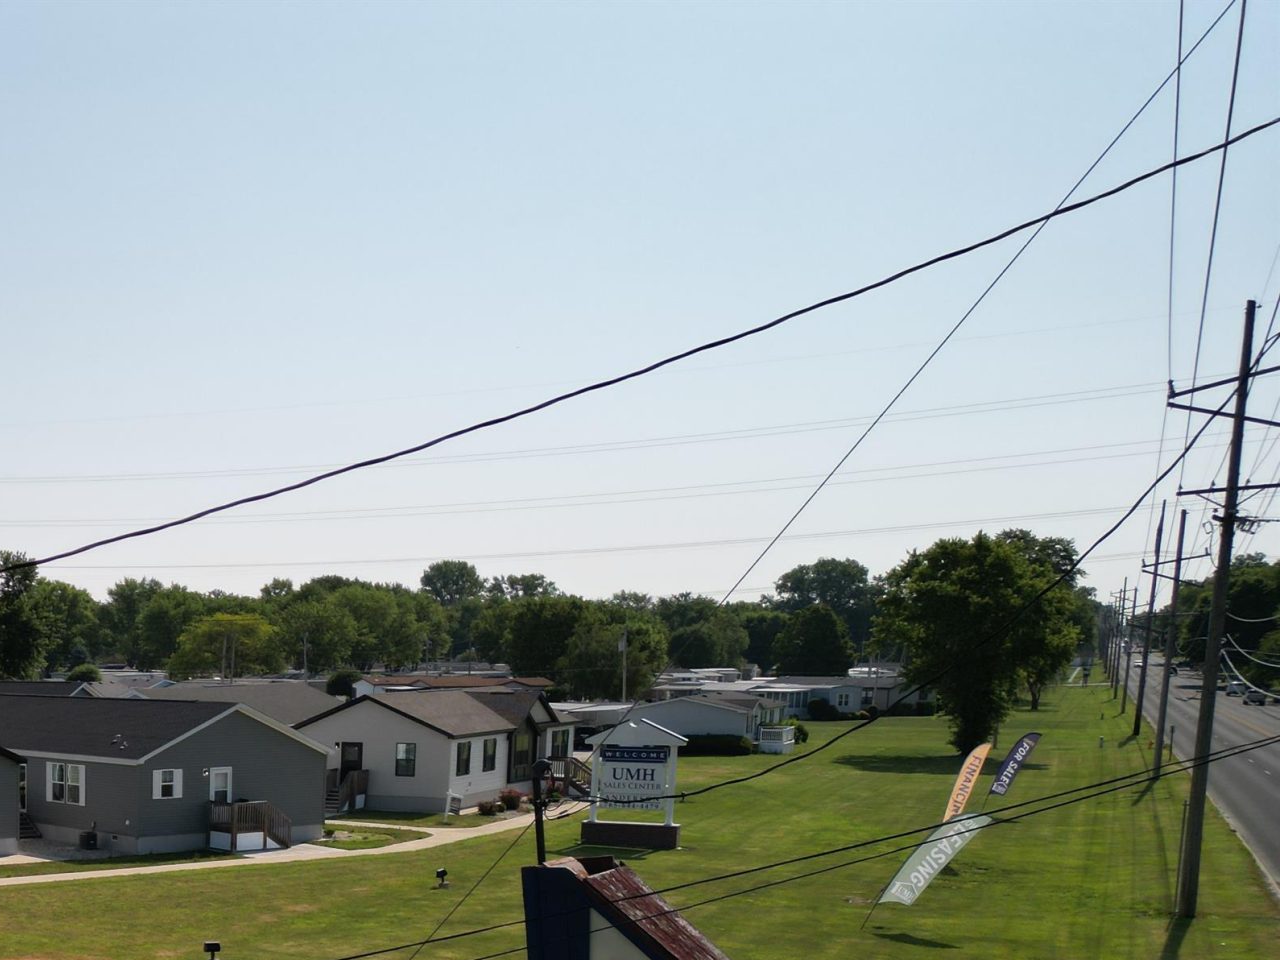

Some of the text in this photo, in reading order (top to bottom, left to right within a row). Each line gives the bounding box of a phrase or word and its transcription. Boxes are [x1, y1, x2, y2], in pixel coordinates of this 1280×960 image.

[1014, 742, 1030, 761] FOR
[612, 767, 656, 781] UMH
[1000, 761, 1018, 785] SALE
[603, 782, 662, 791] SALES CENTER
[952, 755, 982, 816] FINANCIN
[910, 822, 970, 887] LEASING
